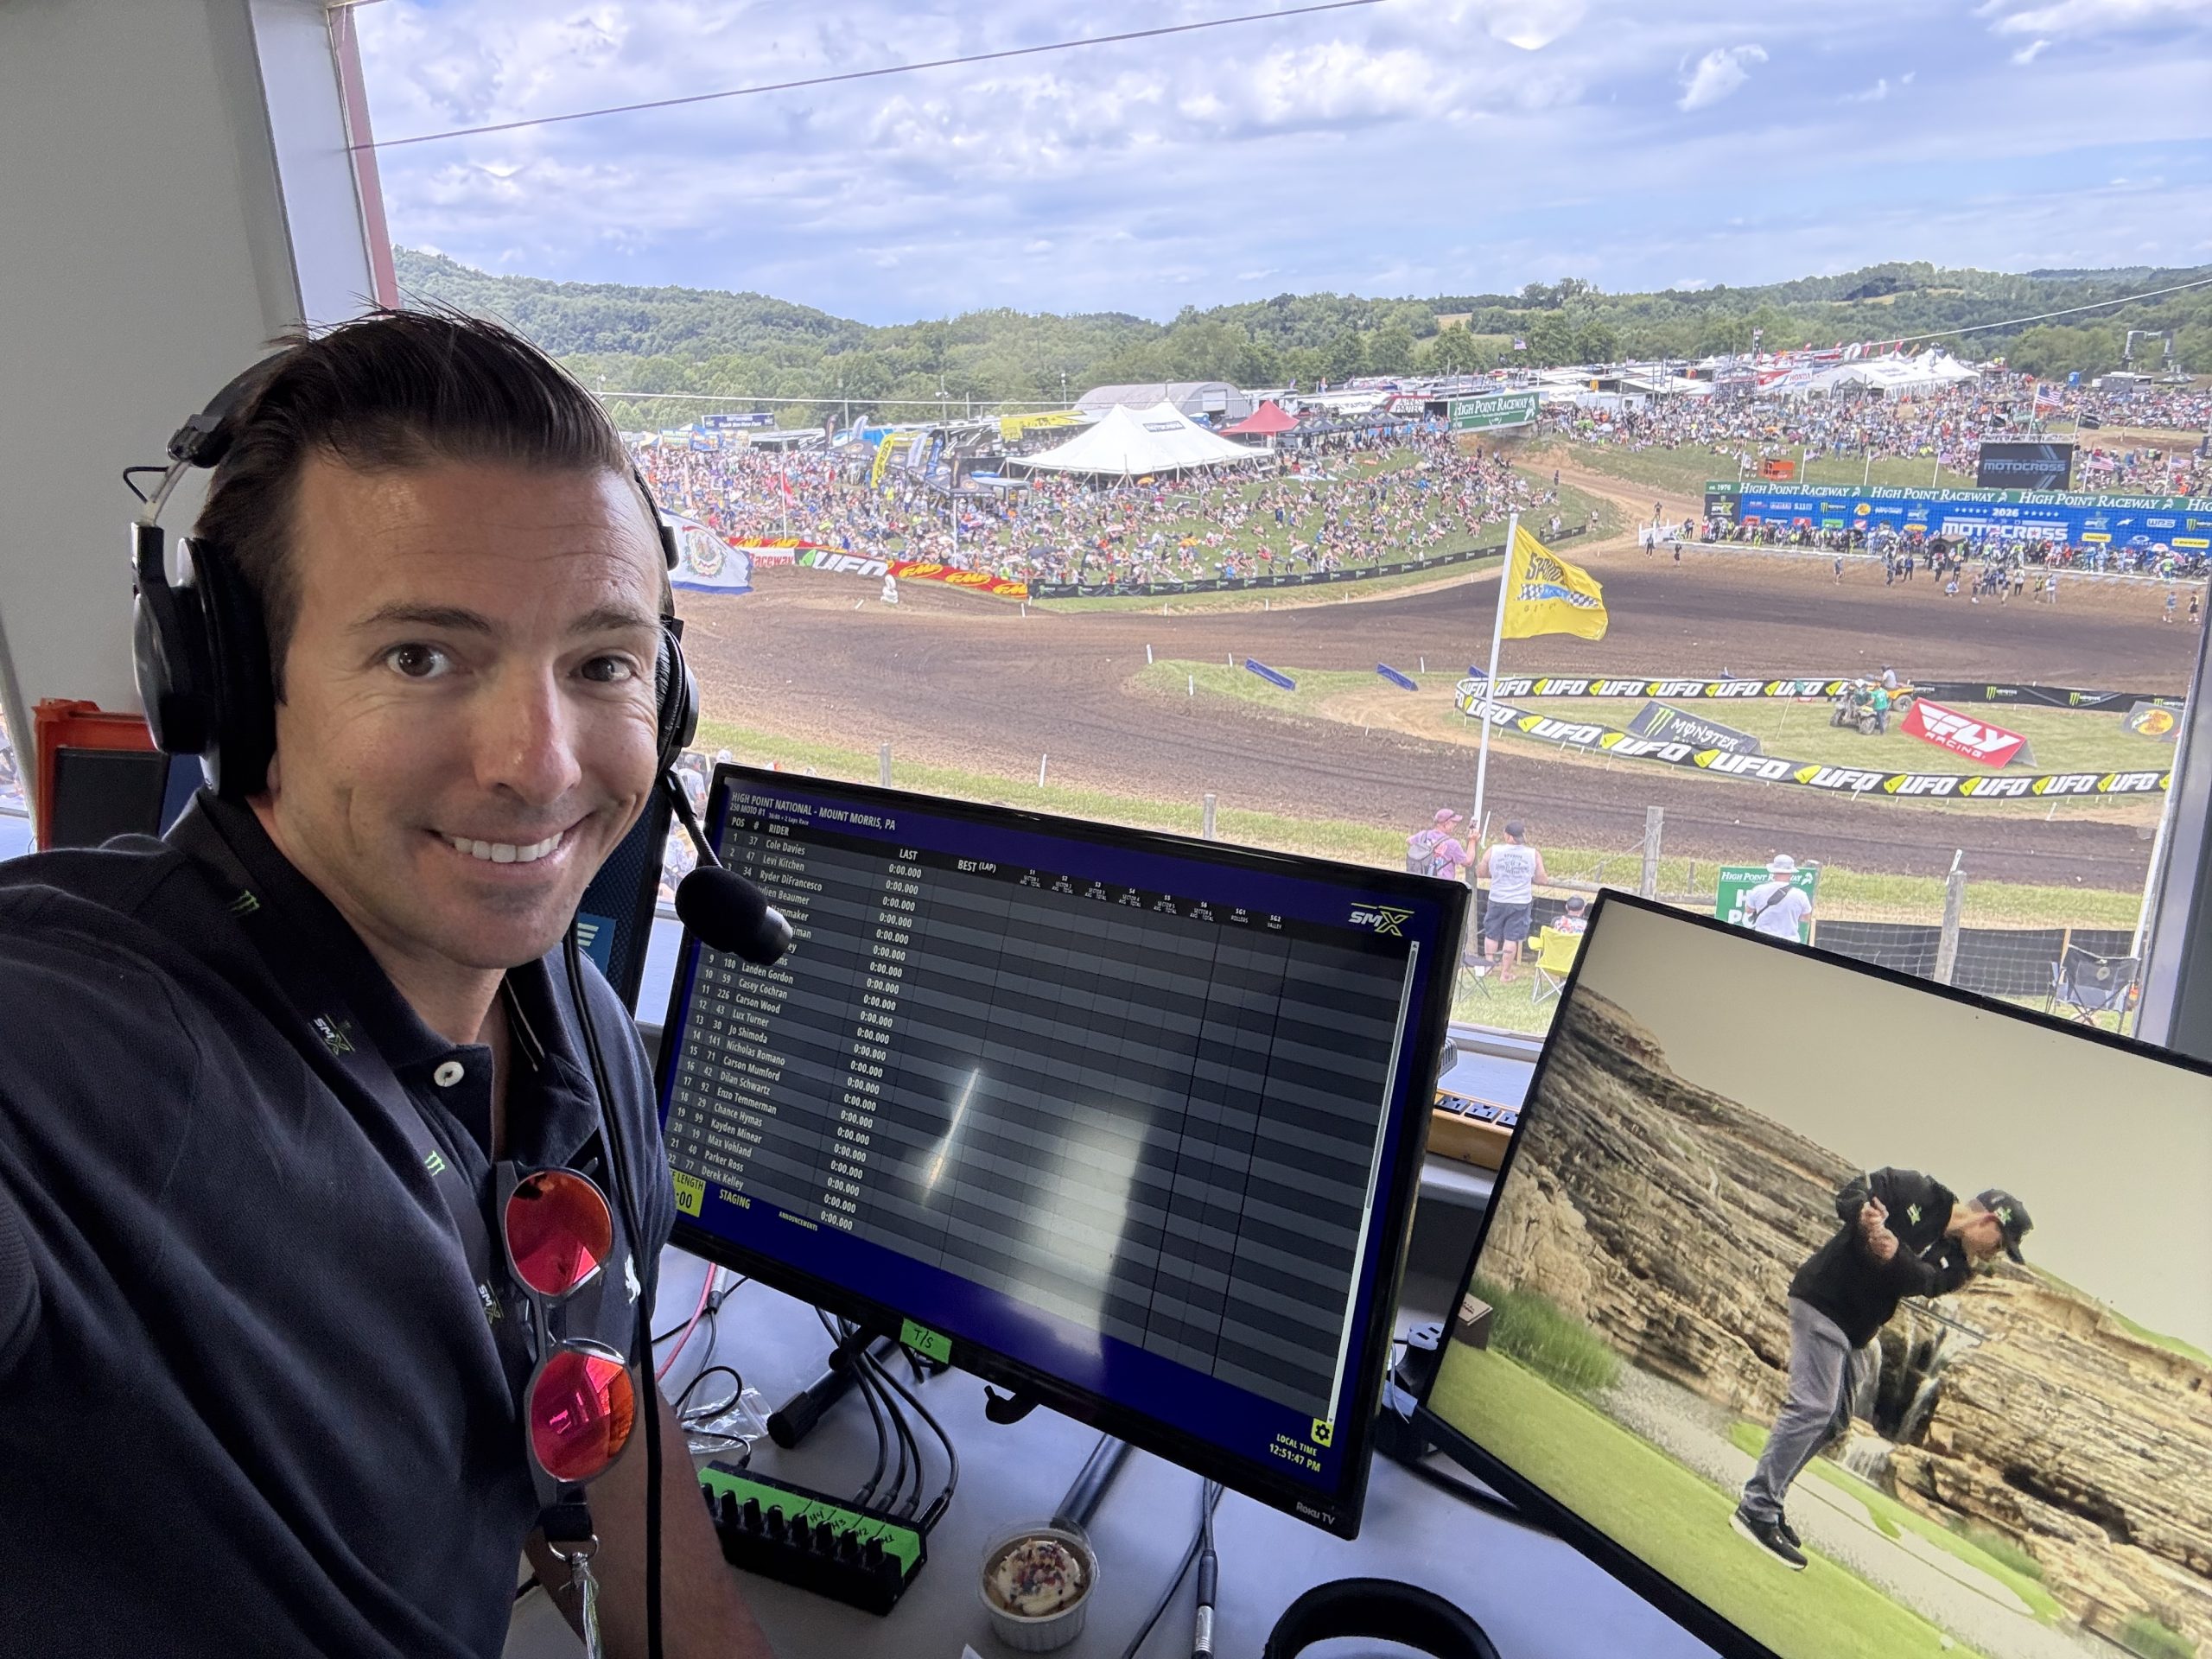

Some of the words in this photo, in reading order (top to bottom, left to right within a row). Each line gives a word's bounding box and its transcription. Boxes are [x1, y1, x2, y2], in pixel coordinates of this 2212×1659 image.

[1453, 401, 1473, 416] HIGH
[1474, 399, 1497, 414] POINT
[1497, 397, 1529, 412] RACEWAY
[1984, 461, 2066, 472] MOTOCROSS
[1739, 482, 1766, 494] HIGH
[1768, 484, 1800, 495] POINT
[1801, 485, 1850, 497] RACEWAY
[1871, 486, 1902, 499] HIGH
[1901, 488, 1939, 500] POINT
[1939, 489, 1995, 502] RACEWAY
[2018, 492, 2055, 505] HIGH
[2055, 493, 2095, 506] POINT
[2096, 495, 2160, 509] RACEWAY
[1993, 507, 2019, 518] 2026
[1942, 522, 2069, 541] MOTOCROSS
[1494, 680, 1532, 696] UFO
[1541, 679, 1588, 696] UFO
[1599, 681, 1645, 696] UFO
[1656, 682, 1703, 696] UFO
[1714, 682, 1763, 696] UFO
[1918, 703, 2021, 753] FLY
[1530, 719, 1602, 744] UFO
[1611, 737, 1692, 761] UFO
[1708, 752, 1790, 779] UFO
[1809, 767, 1884, 791] UFO
[1896, 776, 1958, 794] UFO
[1971, 778, 2031, 796] UFO
[2043, 775, 2098, 794] UFO
[2107, 773, 2158, 791] UFO
[1925, 732, 1982, 759] RACING
[729, 803, 740, 811] 250
[741, 804, 757, 815] MOTO
[732, 791, 750, 804] HIGH
[752, 796, 774, 808] POINT
[775, 800, 812, 816] NATIONAL
[819, 807, 848, 821] MOUNT
[849, 813, 882, 830] MORRIS,
[885, 819, 895, 830] PA
[731, 817, 745, 828] POS
[768, 823, 790, 836] RIDER
[899, 849, 918, 861] LAST
[957, 859, 977, 873] BEST
[978, 861, 996, 874] (LAP)
[749, 836, 758, 846] 37
[766, 839, 781, 851] Cole
[783, 842, 805, 855] Davies
[889, 863, 921, 879] 0:00.000
[747, 852, 755, 861] 47
[763, 855, 777, 866] Levi
[779, 858, 804, 872] Kitchen
[743, 867, 752, 877] 34
[760, 870, 779, 884] Ryder
[781, 874, 823, 892] DiFrancesco
[883, 896, 915, 912] 0:00.000
[1721, 872, 1743, 881] HIGH
[1744, 872, 1767, 881] POINT
[779, 889, 810, 906] Beaumer
[876, 929, 908, 944] 0:00.000
[709, 954, 715, 963] 9
[724, 957, 736, 969] 180
[742, 963, 766, 977] Landen
[768, 968, 793, 984] Gordon
[864, 995, 896, 1011] 0:00.000
[870, 961, 902, 977] 0:00.000
[705, 969, 713, 979] 10
[722, 974, 731, 983] 59
[739, 978, 758, 992] Casey
[760, 983, 788, 999] Cochran
[699, 1000, 707, 1010] 12
[715, 1004, 725, 1014] 43
[733, 1009, 744, 1020] Lux
[746, 1014, 769, 1027] Turner
[702, 984, 709, 995] 11
[717, 988, 730, 1000] 226
[735, 994, 759, 1008] Carson
[760, 999, 781, 1014] Wood
[857, 1027, 889, 1044] 0:00.000
[693, 1030, 701, 1040] 14
[709, 1034, 721, 1046] 141
[727, 1040, 755, 1057] Nicholas
[757, 1049, 785, 1066] Romano
[696, 1014, 704, 1025] 13
[713, 1020, 722, 1030] 30
[728, 1024, 737, 1036] Jo
[738, 1027, 768, 1044] Shimoda
[851, 1060, 882, 1077] 0:00.000
[687, 1060, 695, 1071] 16
[703, 1066, 713, 1077] 42
[720, 1071, 738, 1085] Dilan
[739, 1077, 771, 1096] Schwartz
[690, 1046, 698, 1056] 15
[707, 1050, 715, 1061] 71
[723, 1056, 747, 1071] Carson
[747, 1063, 780, 1081] Mumford
[844, 1094, 875, 1111] 0:00.000
[680, 1091, 689, 1102] 18
[697, 1097, 706, 1108] 29
[715, 1103, 738, 1119] Chance
[739, 1110, 762, 1127] Hymas
[683, 1076, 691, 1086] 17
[701, 1081, 709, 1092] 92
[717, 1087, 733, 1100] Enzo
[734, 1092, 777, 1115] Temmerman
[837, 1127, 869, 1145] 0:00.000
[674, 1122, 683, 1133] 20
[692, 1128, 701, 1139] 19
[708, 1135, 722, 1147] Max
[724, 1140, 752, 1158] Vohland
[677, 1107, 685, 1117] 19
[695, 1112, 703, 1123] 99
[711, 1118, 735, 1135] Kayden
[737, 1127, 762, 1144] Minear
[831, 1160, 862, 1179] 0:00.000
[668, 1154, 677, 1164] 22
[685, 1159, 694, 1170] 77
[702, 1166, 721, 1181] Derek
[722, 1173, 743, 1191] Kelley
[671, 1138, 679, 1148] 21
[689, 1143, 697, 1154] 40
[705, 1150, 727, 1165] Parker
[728, 1158, 744, 1172] Ross
[824, 1193, 855, 1213] 0:00.000
[677, 1173, 704, 1192] LENGTH
[719, 1188, 751, 1210] STAGING
[913, 1326, 934, 1349] T/S
[1269, 1443, 1305, 1465] 12:51:47
[1306, 1459, 1321, 1472] PM
[1276, 1433, 1297, 1449] LOCAL
[1300, 1442, 1317, 1457] TIME
[1322, 1512, 1336, 1525] TV
